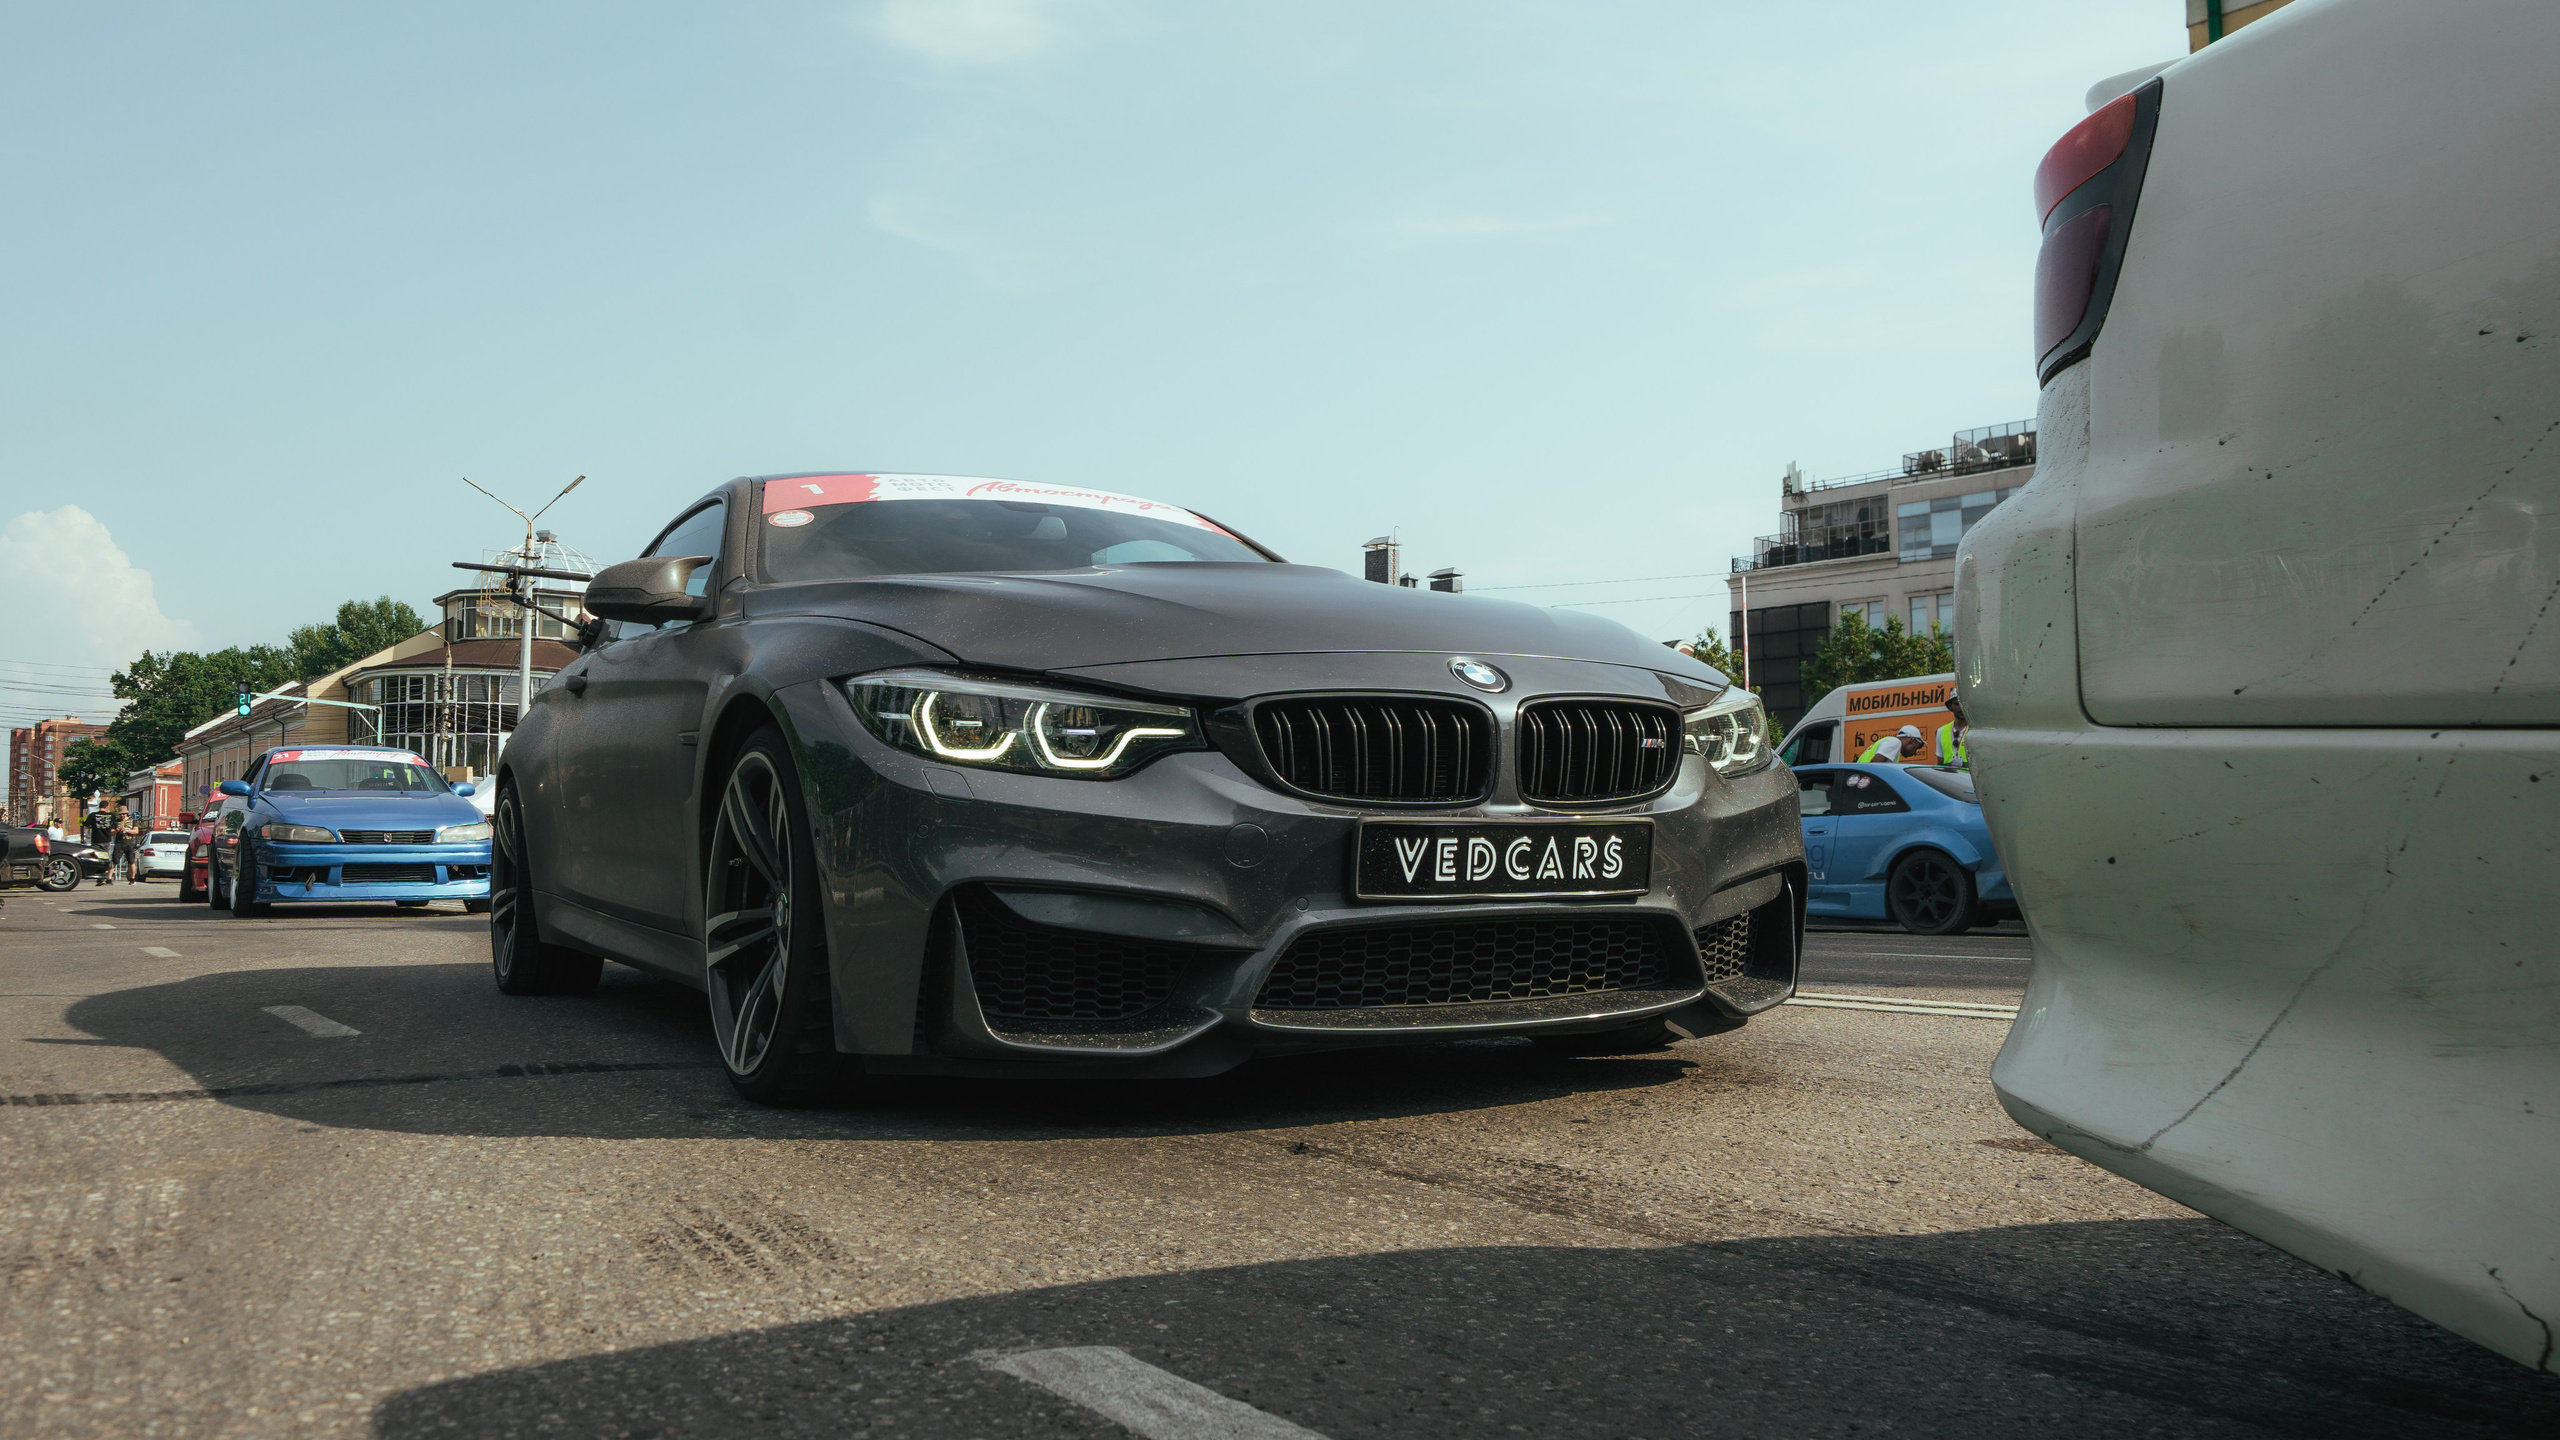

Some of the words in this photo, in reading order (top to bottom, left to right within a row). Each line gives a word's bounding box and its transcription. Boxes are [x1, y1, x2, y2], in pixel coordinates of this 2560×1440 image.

[800, 483, 824, 495] 1
[239, 693, 251, 704] 21
[1849, 684, 1945, 712] МОБИЛЬНЫЙ
[1395, 835, 1624, 883] VEDCARS
